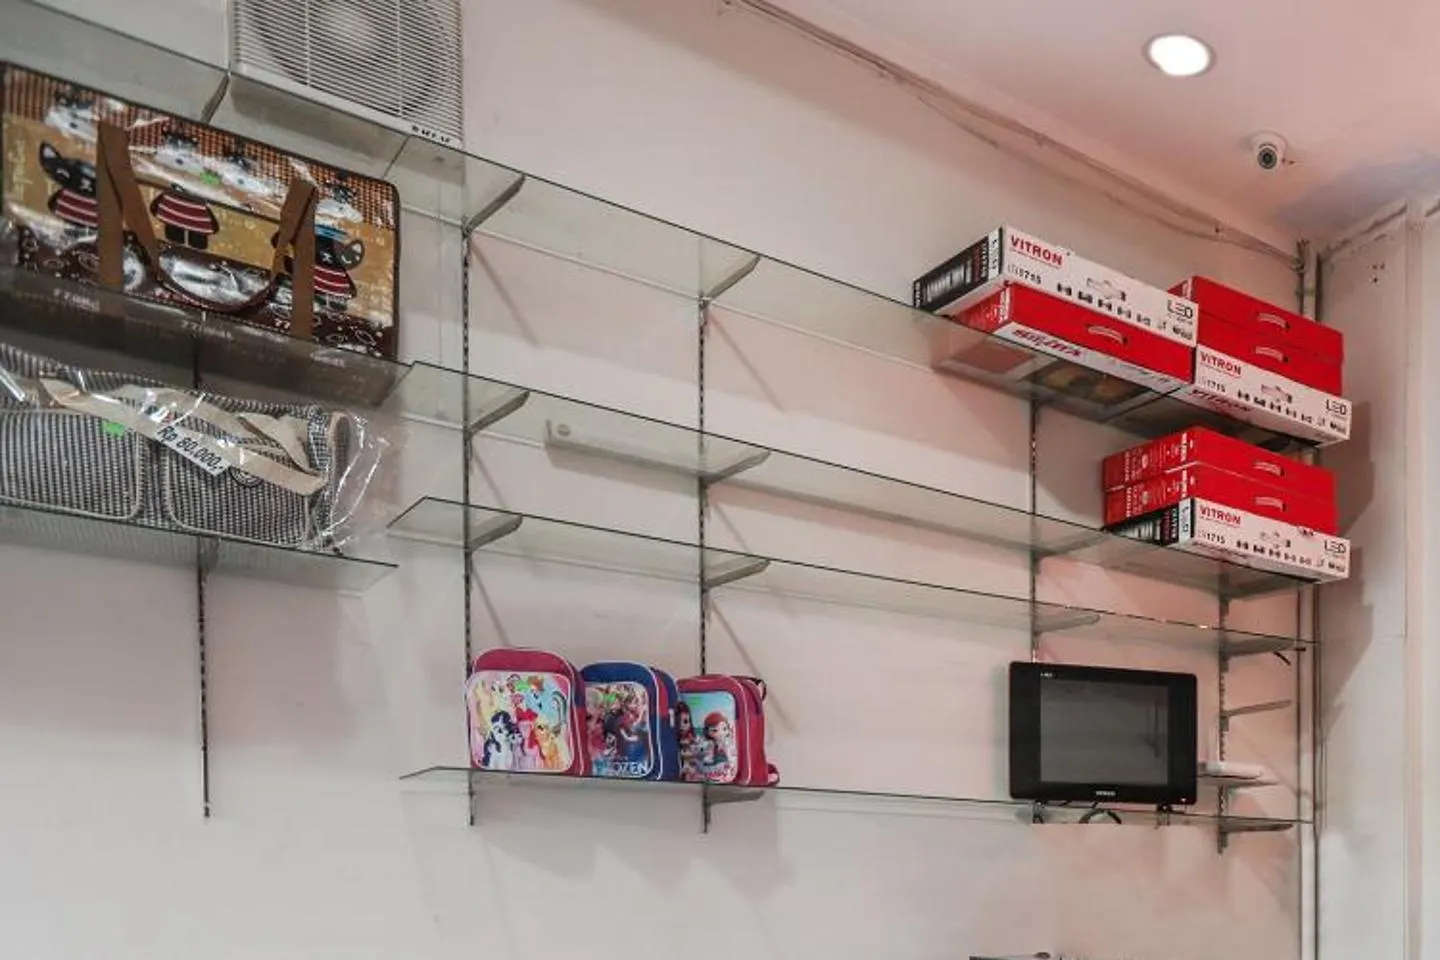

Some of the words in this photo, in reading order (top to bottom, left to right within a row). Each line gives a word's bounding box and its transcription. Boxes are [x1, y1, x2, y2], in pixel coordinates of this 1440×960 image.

[1010, 234, 1063, 266] VITRON
[1167, 299, 1194, 320] LED
[1201, 352, 1242, 375] VITRON
[1325, 398, 1348, 416] LED
[157, 425, 179, 442] Rp
[1200, 503, 1242, 525] VITRON
[1324, 539, 1347, 555] LED
